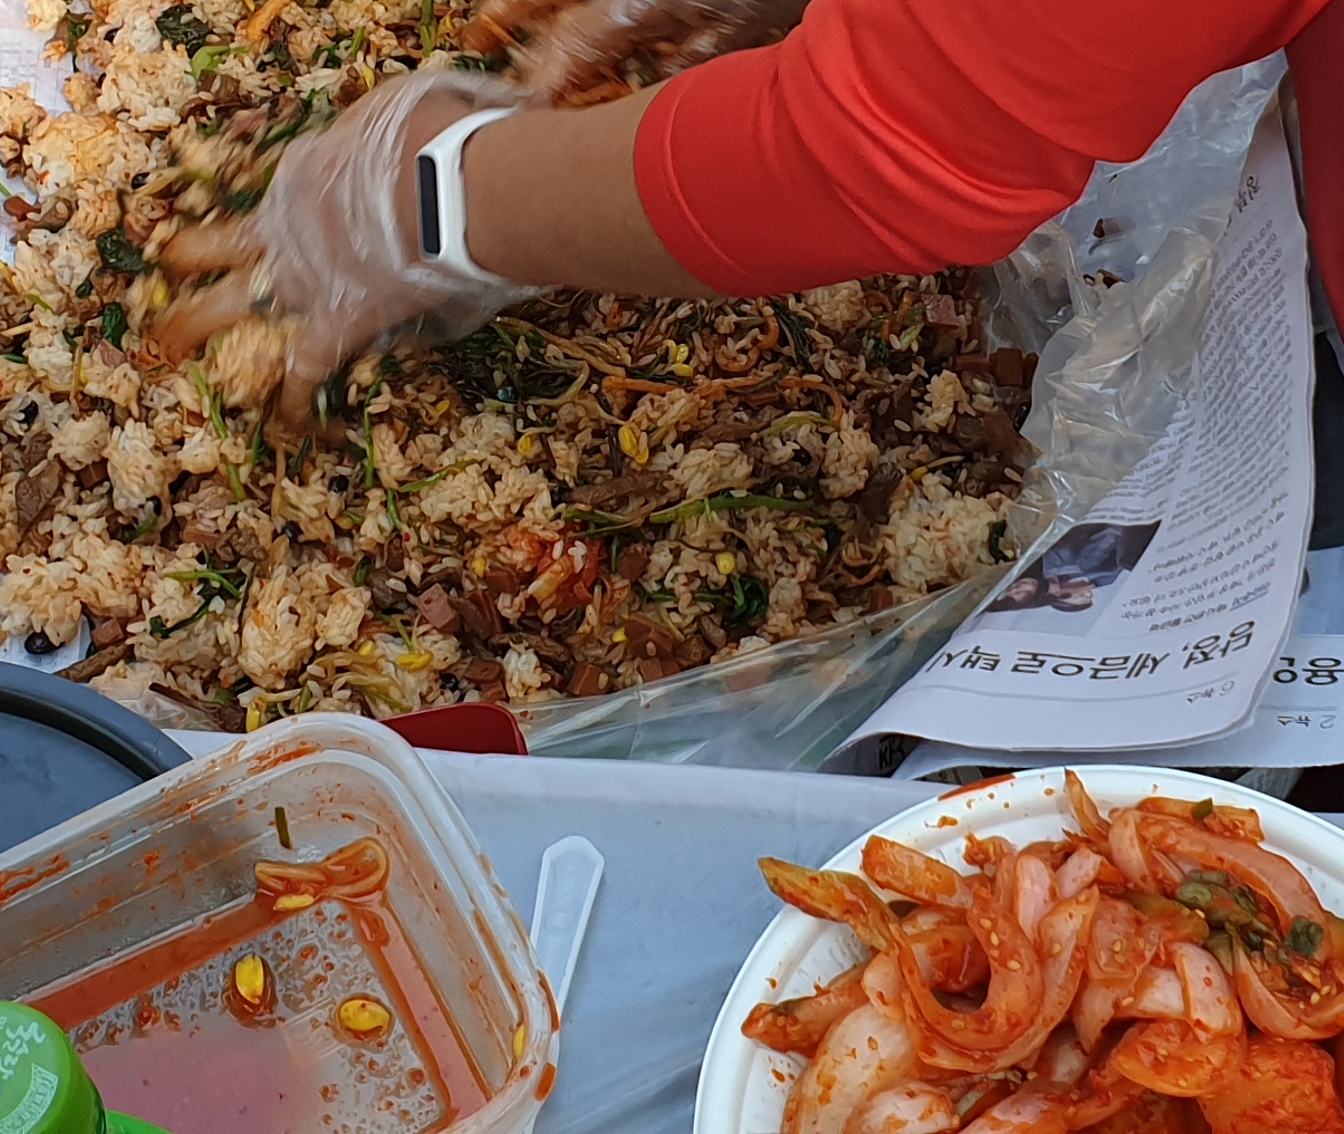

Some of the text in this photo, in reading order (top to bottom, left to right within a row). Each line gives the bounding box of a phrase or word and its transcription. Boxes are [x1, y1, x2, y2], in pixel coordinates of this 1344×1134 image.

[926, 621, 1256, 680] 당정, 세금으로 택시
[1276, 714, 1337, 730] 2 뉴스
